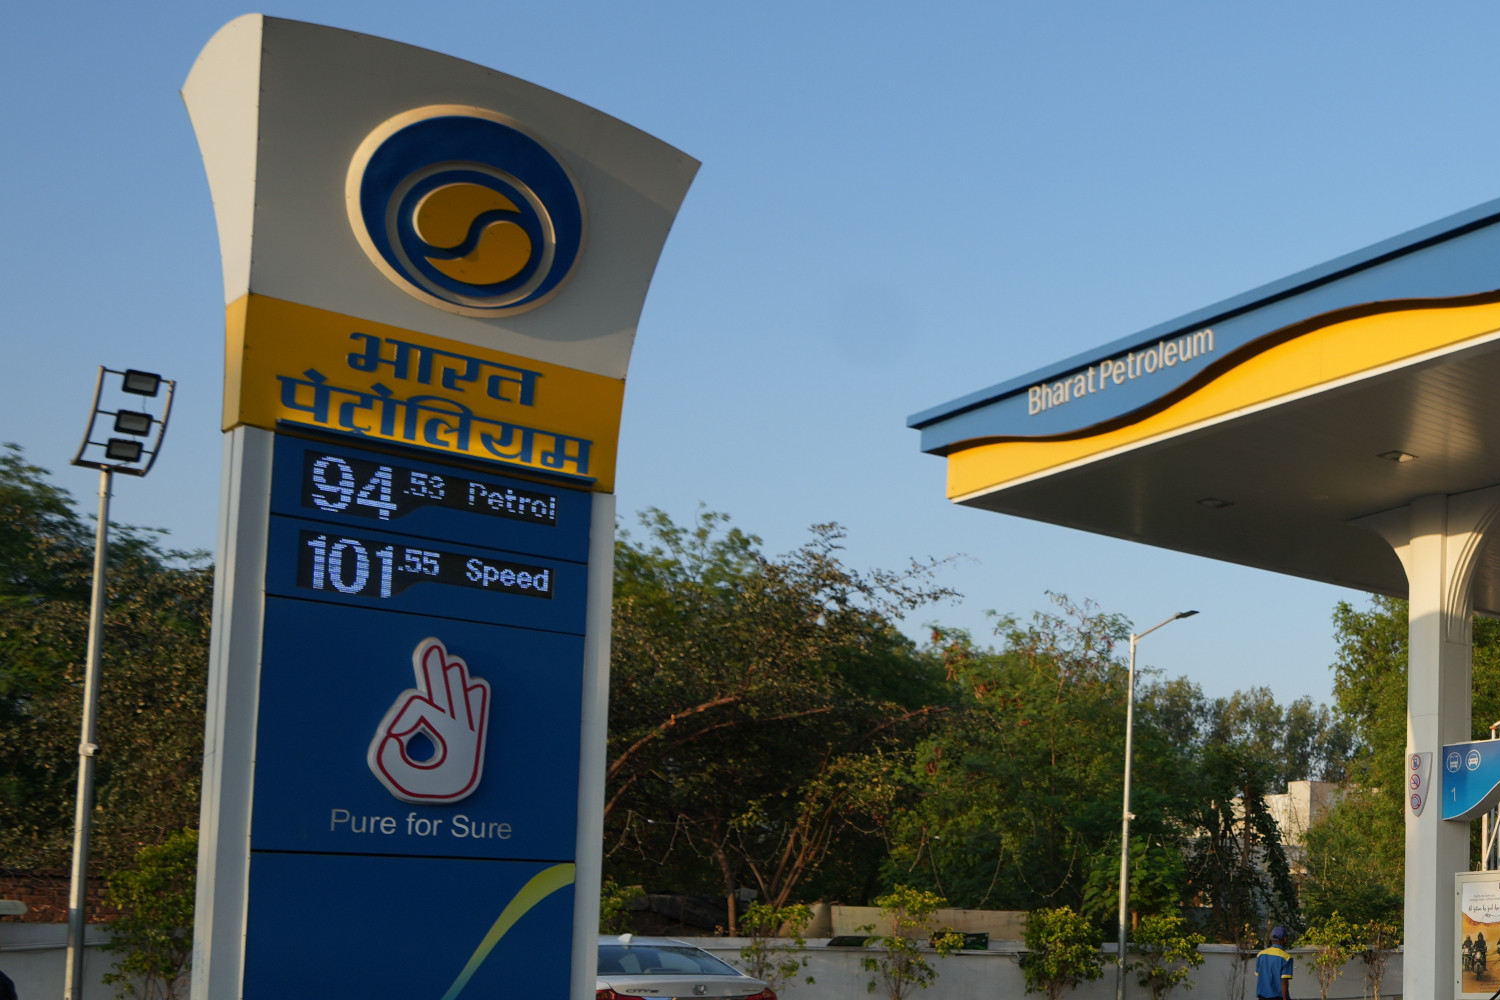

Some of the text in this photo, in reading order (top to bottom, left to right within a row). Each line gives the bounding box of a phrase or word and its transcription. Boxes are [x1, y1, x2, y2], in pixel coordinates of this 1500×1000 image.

[346, 332, 543, 407] भारत
[1028, 328, 1214, 416] Bharat Petroleum
[276, 368, 594, 475] पेट्रोलियम
[469, 481, 556, 520] Petrol
[466, 558, 549, 593] Speed
[1451, 786, 1457, 802] 1
[330, 808, 513, 839] Pure for Sure
